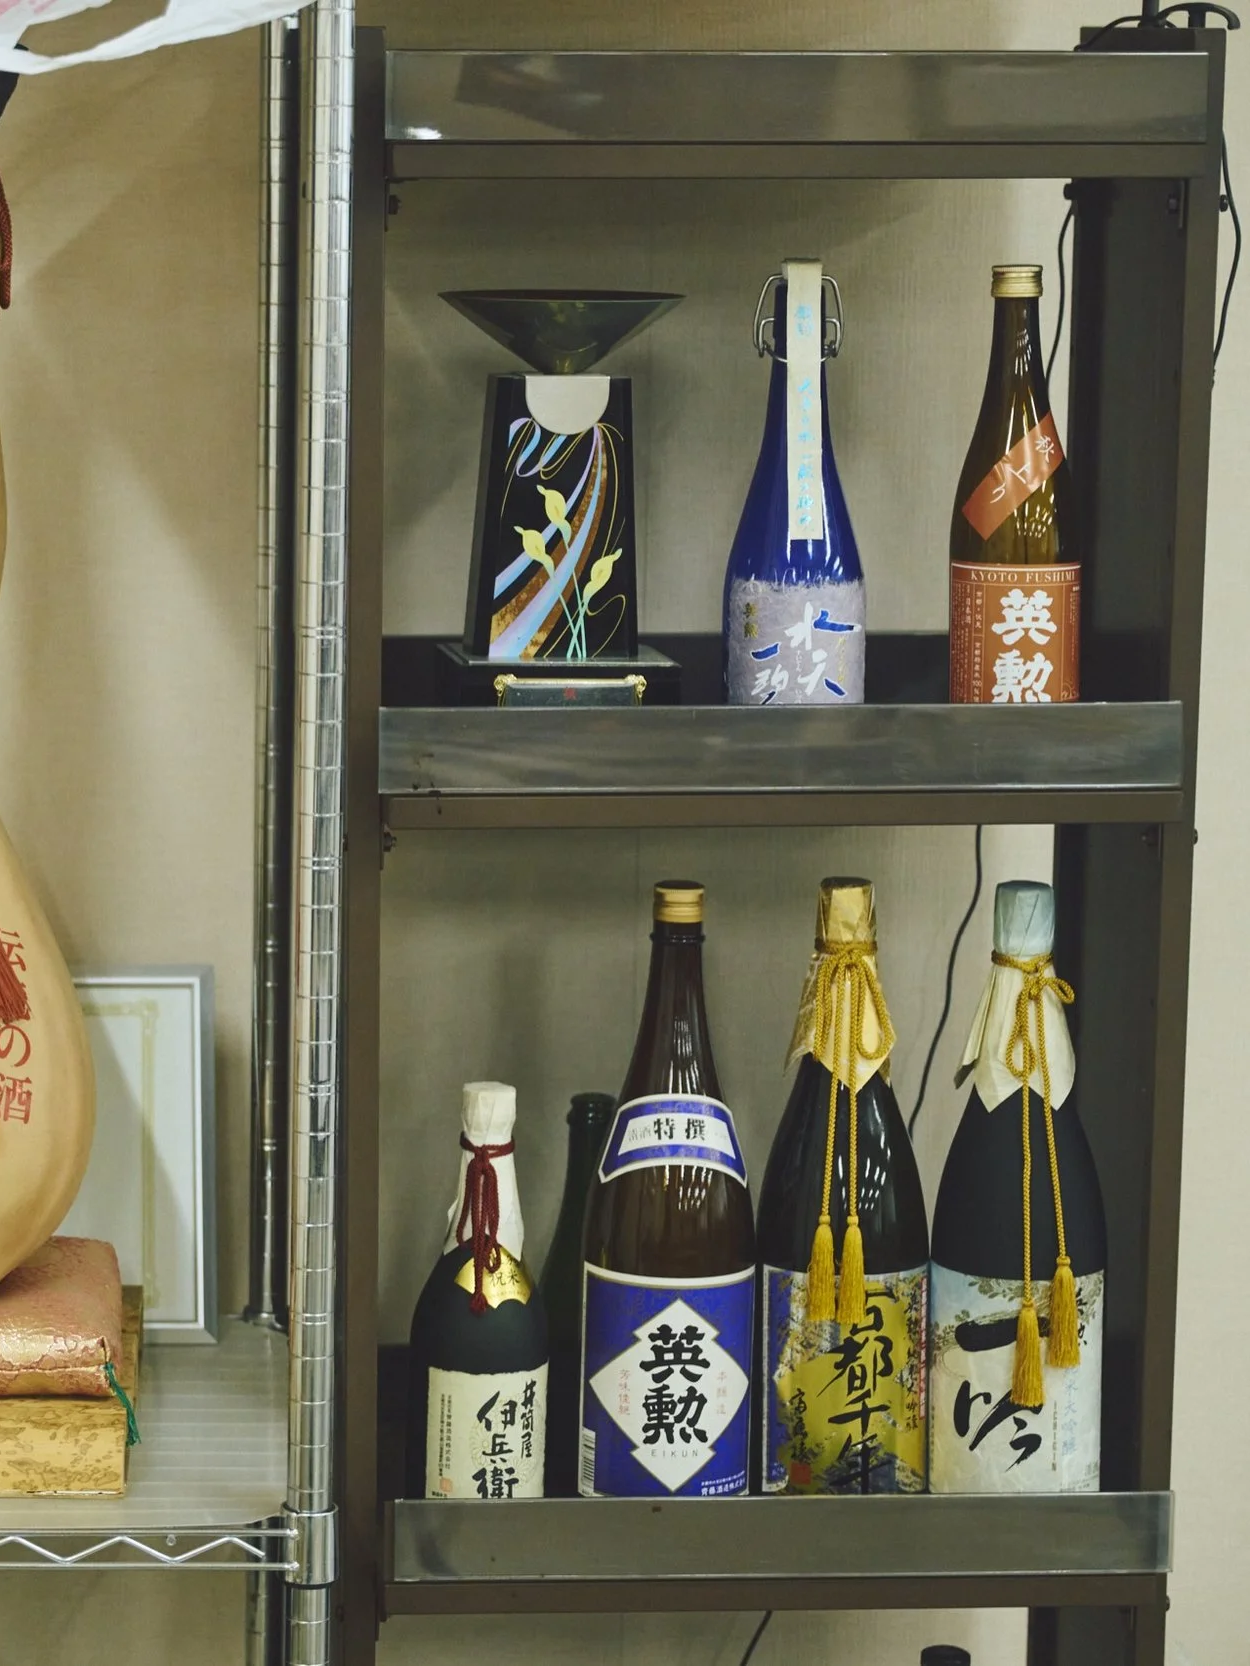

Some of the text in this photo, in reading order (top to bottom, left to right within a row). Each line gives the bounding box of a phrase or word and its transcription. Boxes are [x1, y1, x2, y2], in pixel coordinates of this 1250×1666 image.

[970, 570, 1075, 583] KYOTO FUSHIMI
[991, 588, 1057, 703] 英勲
[653, 1117, 705, 1141] 特撰
[639, 1324, 711, 1445] 英勲
[472, 1390, 520, 1499] 伊兵衛
[651, 1449, 699, 1458] EIKUN
